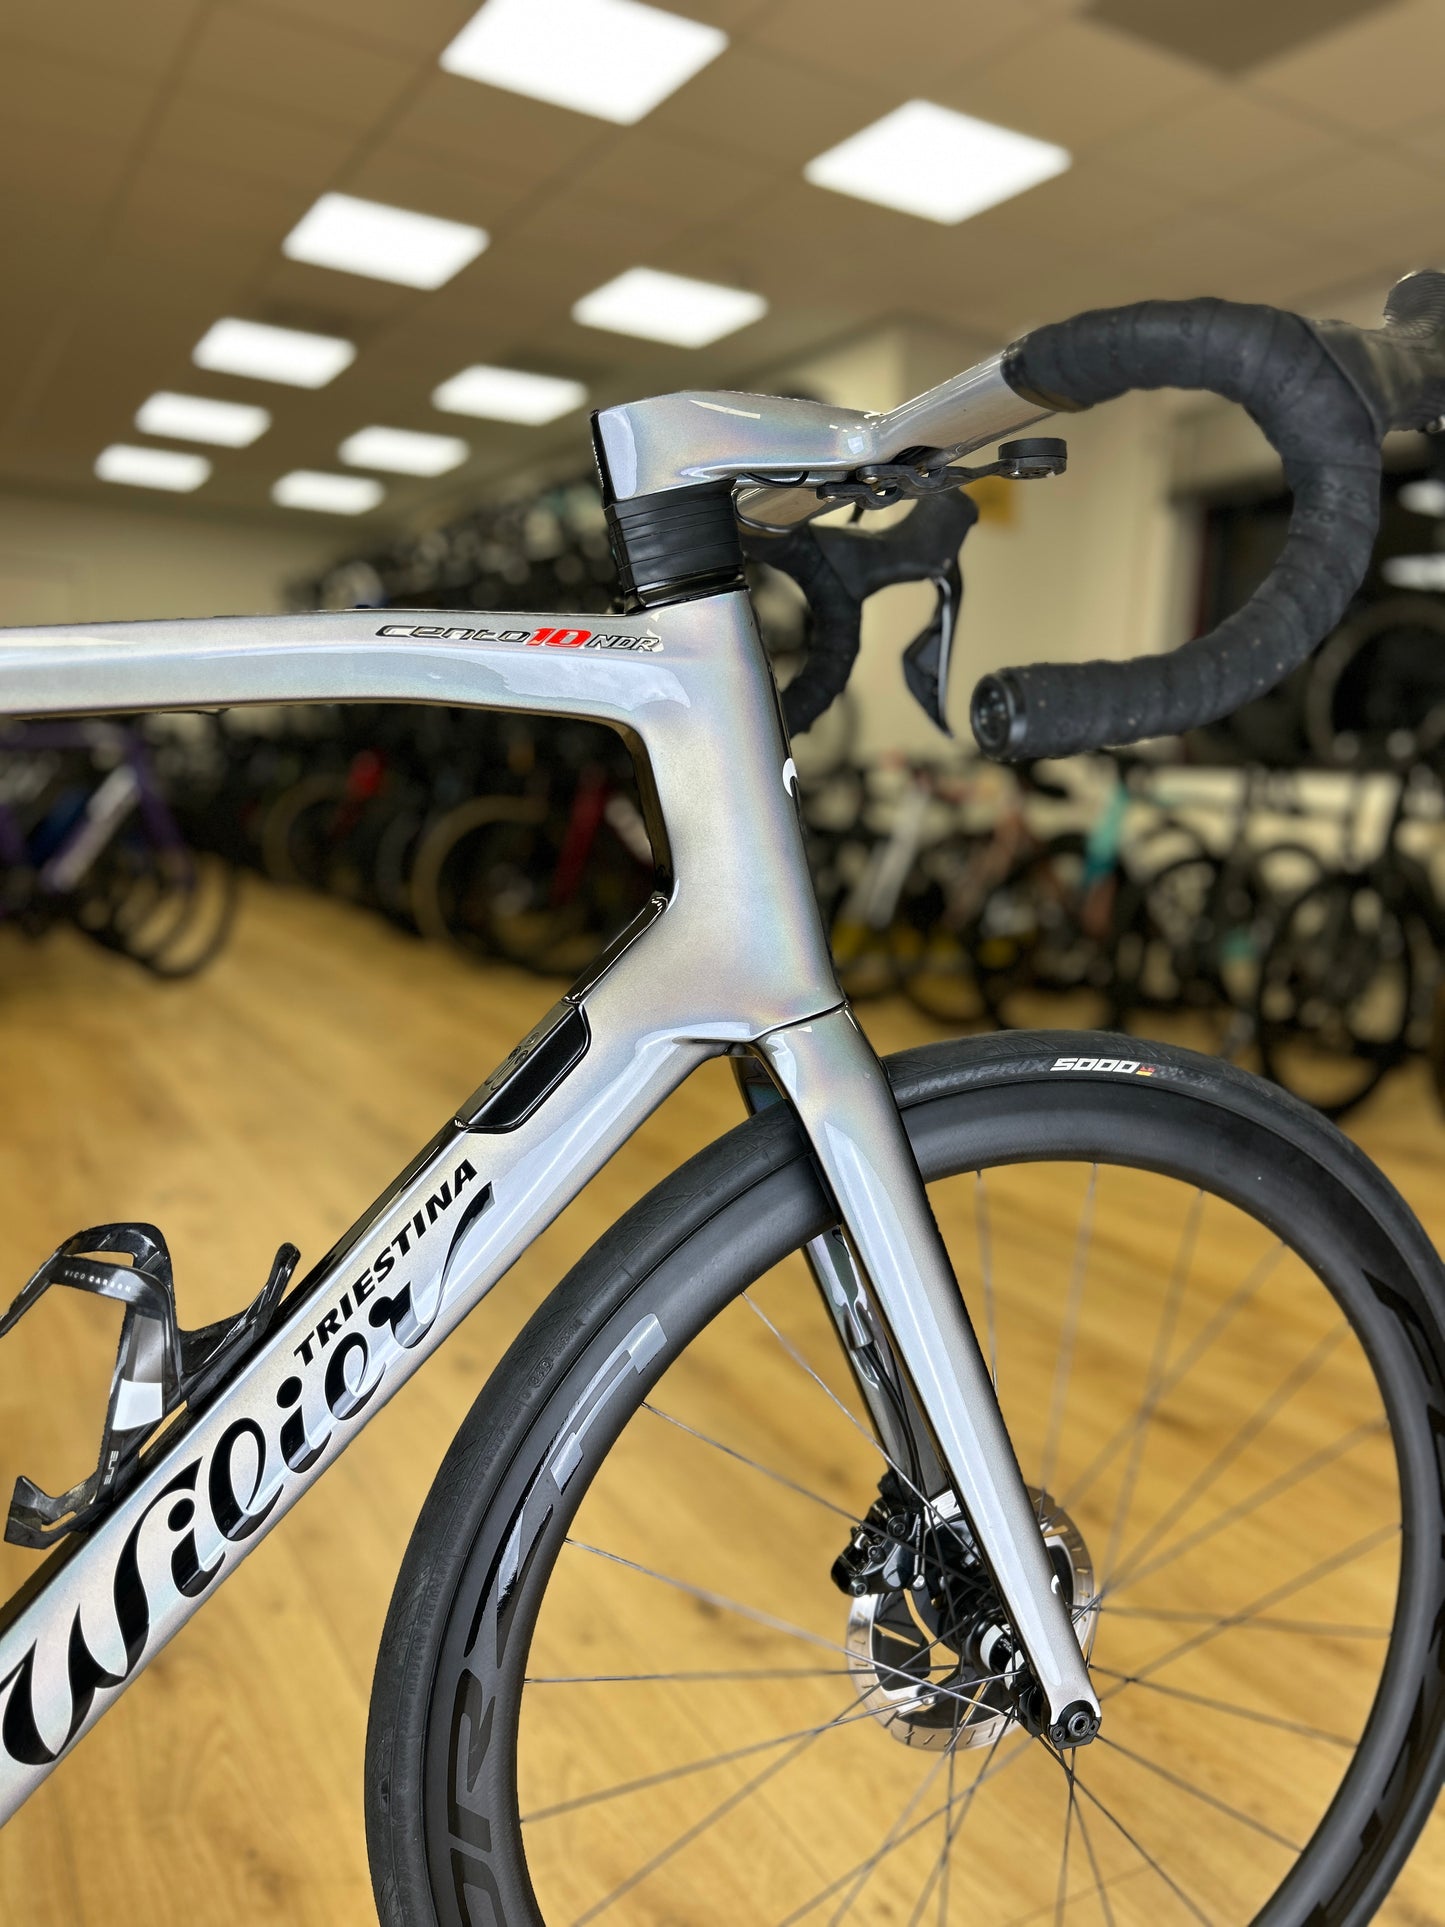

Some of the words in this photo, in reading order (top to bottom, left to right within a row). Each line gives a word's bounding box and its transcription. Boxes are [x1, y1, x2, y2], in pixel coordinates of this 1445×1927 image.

[1050, 1057, 1141, 1074] 5000
[88, 1275, 133, 1294] CARBON
[293, 1159, 478, 1365] TRIESTINA
[0, 1181, 495, 1766] Wilier
